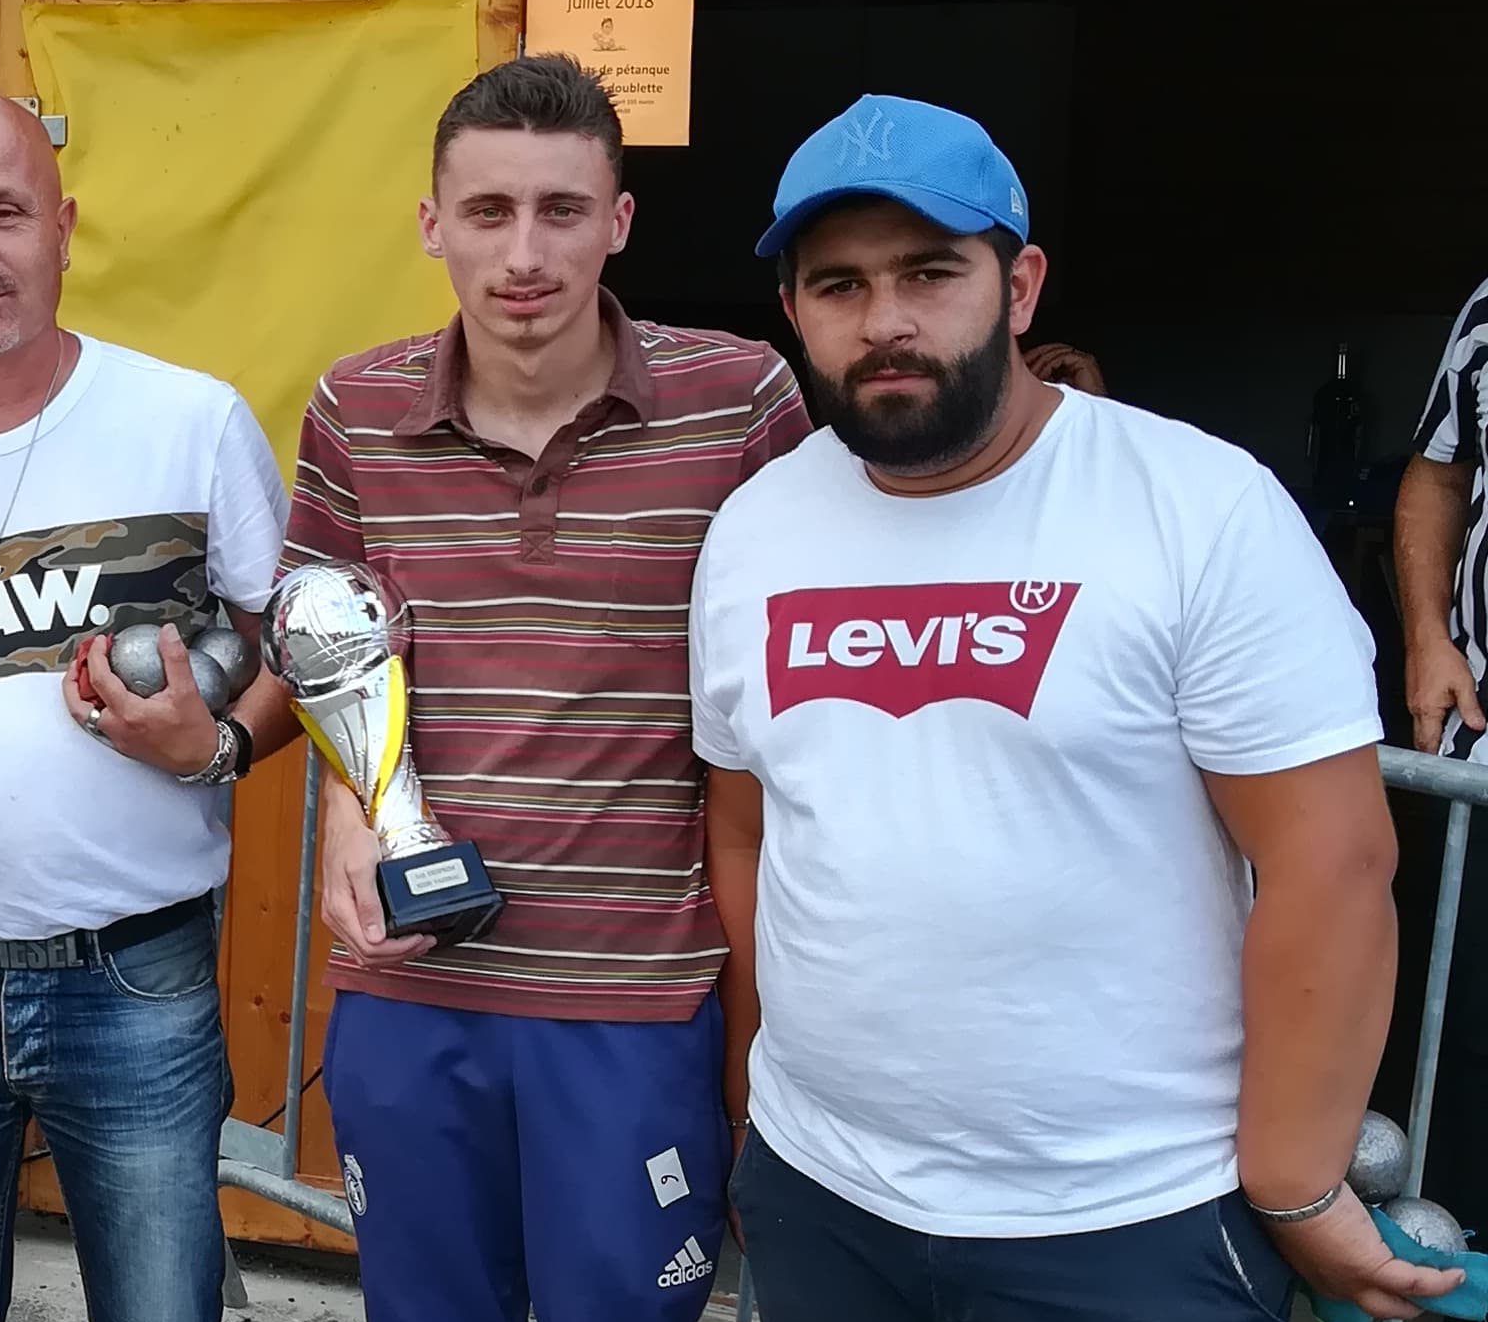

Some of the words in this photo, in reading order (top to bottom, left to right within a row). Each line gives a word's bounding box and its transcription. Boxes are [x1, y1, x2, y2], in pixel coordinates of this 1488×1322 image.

[616, 64, 670, 77] pétanque
[608, 82, 663, 93] doublette
[657, 1260, 713, 1288] adidas
